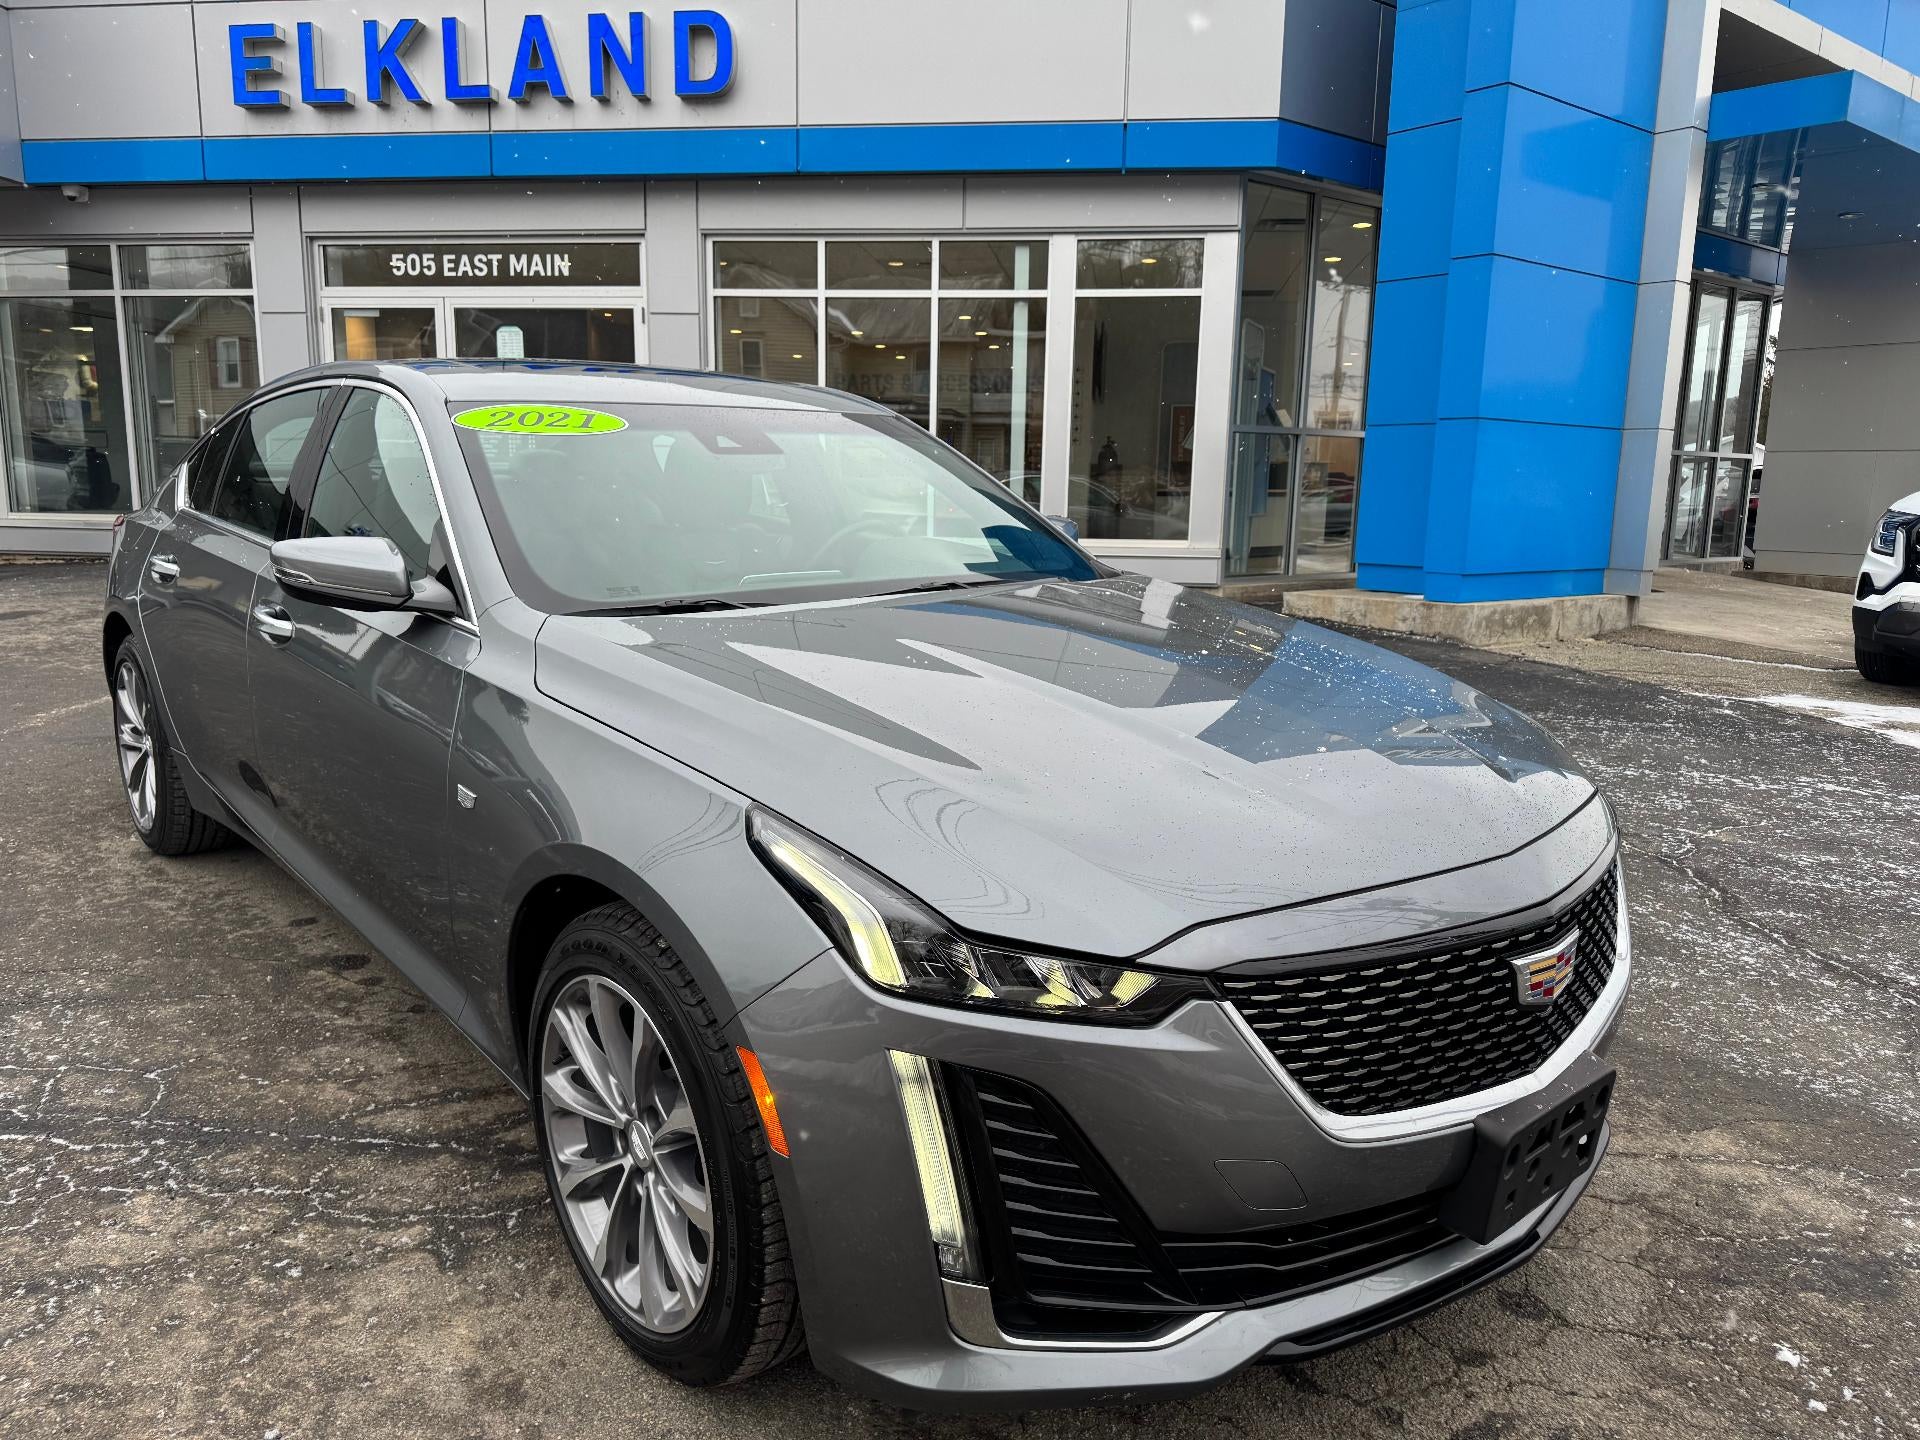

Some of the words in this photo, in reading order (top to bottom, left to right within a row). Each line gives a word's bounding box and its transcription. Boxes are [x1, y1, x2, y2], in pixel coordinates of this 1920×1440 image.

[229, 10, 736, 106] ELKLAND
[391, 253, 436, 276] 505
[442, 253, 502, 277] EAST
[509, 253, 570, 277] MAIN
[486, 410, 596, 429] 2021
